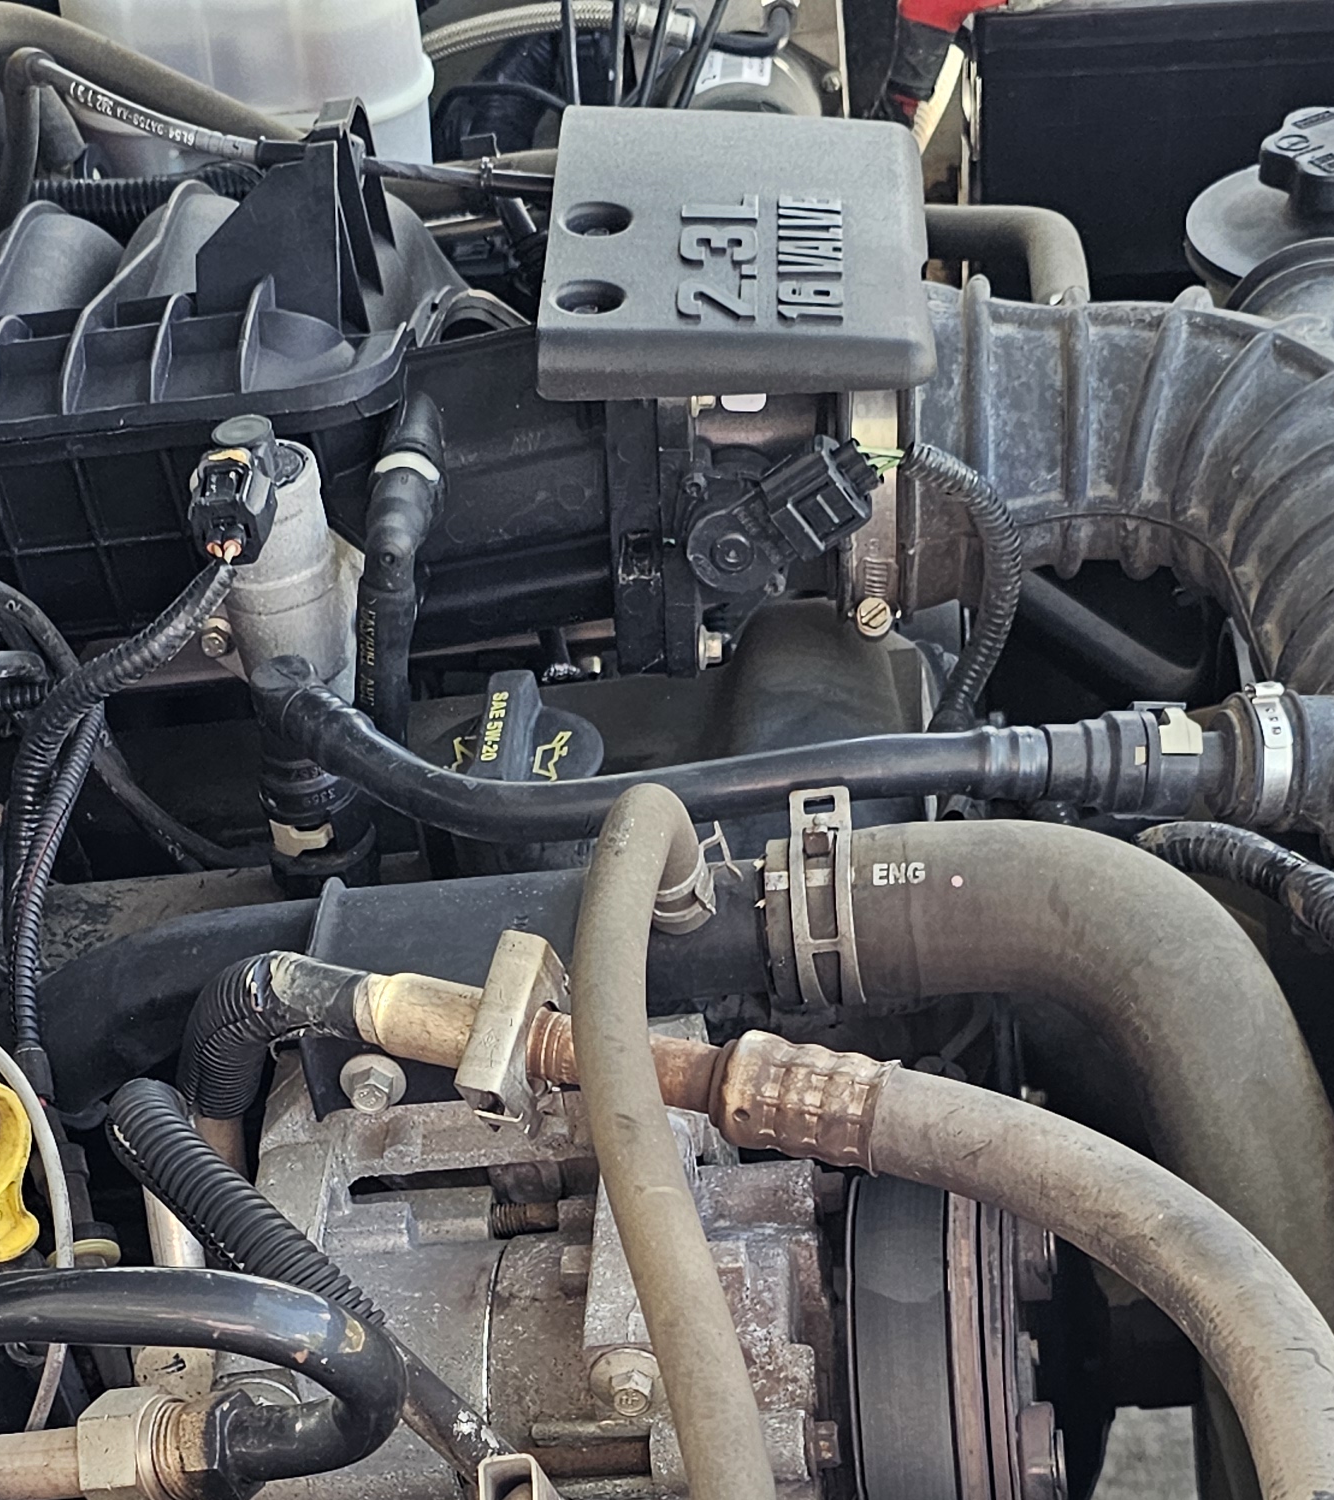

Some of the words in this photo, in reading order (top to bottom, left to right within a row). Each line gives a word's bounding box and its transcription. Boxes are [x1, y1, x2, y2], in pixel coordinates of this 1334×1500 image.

[776, 195, 842, 279] VALVE
[776, 280, 843, 326] 16
[7, 598, 21, 612] 2
[488, 691, 509, 719] SAE
[480, 720, 503, 761] 5W-20
[872, 861, 925, 885] ENG
